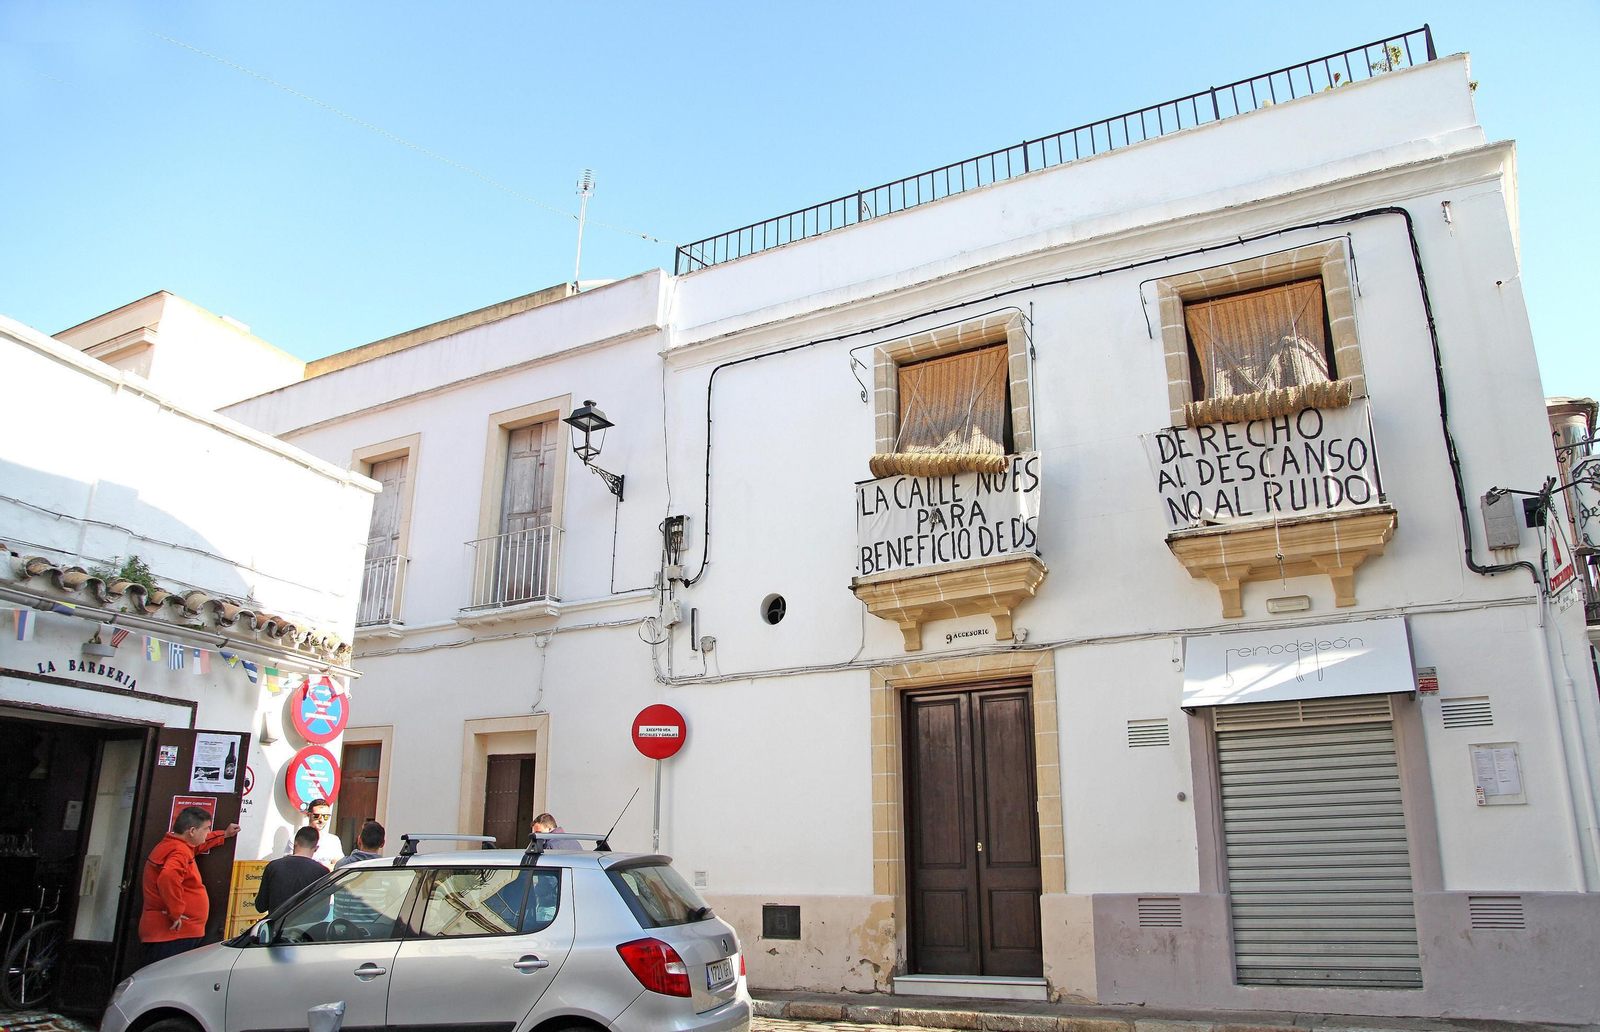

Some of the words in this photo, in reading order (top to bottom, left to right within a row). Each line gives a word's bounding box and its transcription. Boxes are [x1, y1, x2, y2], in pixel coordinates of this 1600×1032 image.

[1155, 407, 1324, 465] DERECHO
[861, 486, 890, 517] LA
[894, 473, 963, 510] CALLE
[976, 471, 1008, 497] NO
[1012, 456, 1040, 494] ES
[1158, 463, 1187, 494] AL
[1195, 437, 1369, 487] DESCANSO
[917, 500, 987, 536] PARA
[1166, 490, 1203, 526] NO
[1213, 486, 1253, 520] AL
[1263, 474, 1371, 514] RUIDO
[861, 528, 972, 576] BENEFICIO
[978, 521, 1008, 558] DE
[945, 633, 953, 645] 9
[953, 628, 990, 639] ACCESORIO
[37, 660, 56, 674] LA
[68, 659, 137, 691] BARBERIA
